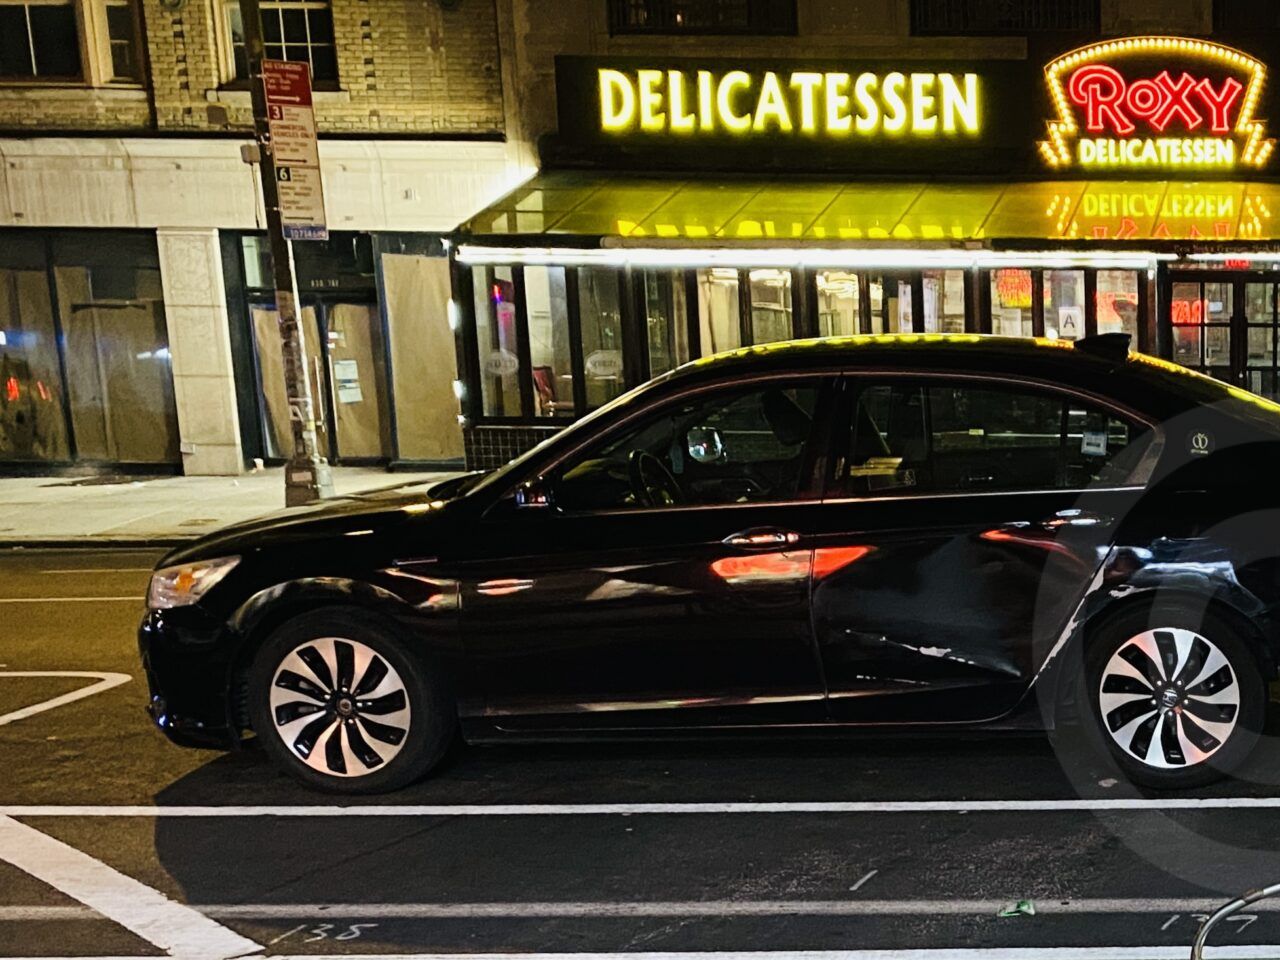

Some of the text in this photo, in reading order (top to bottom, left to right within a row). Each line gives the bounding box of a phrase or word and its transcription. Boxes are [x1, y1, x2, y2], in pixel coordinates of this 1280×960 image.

[598, 69, 980, 132] DELICATESSEN
[272, 106, 281, 119] 3
[1078, 138, 1234, 163] DELICATESSEN
[279, 167, 288, 180] 6
[1063, 314, 1075, 328] A
[269, 924, 379, 945] 135
